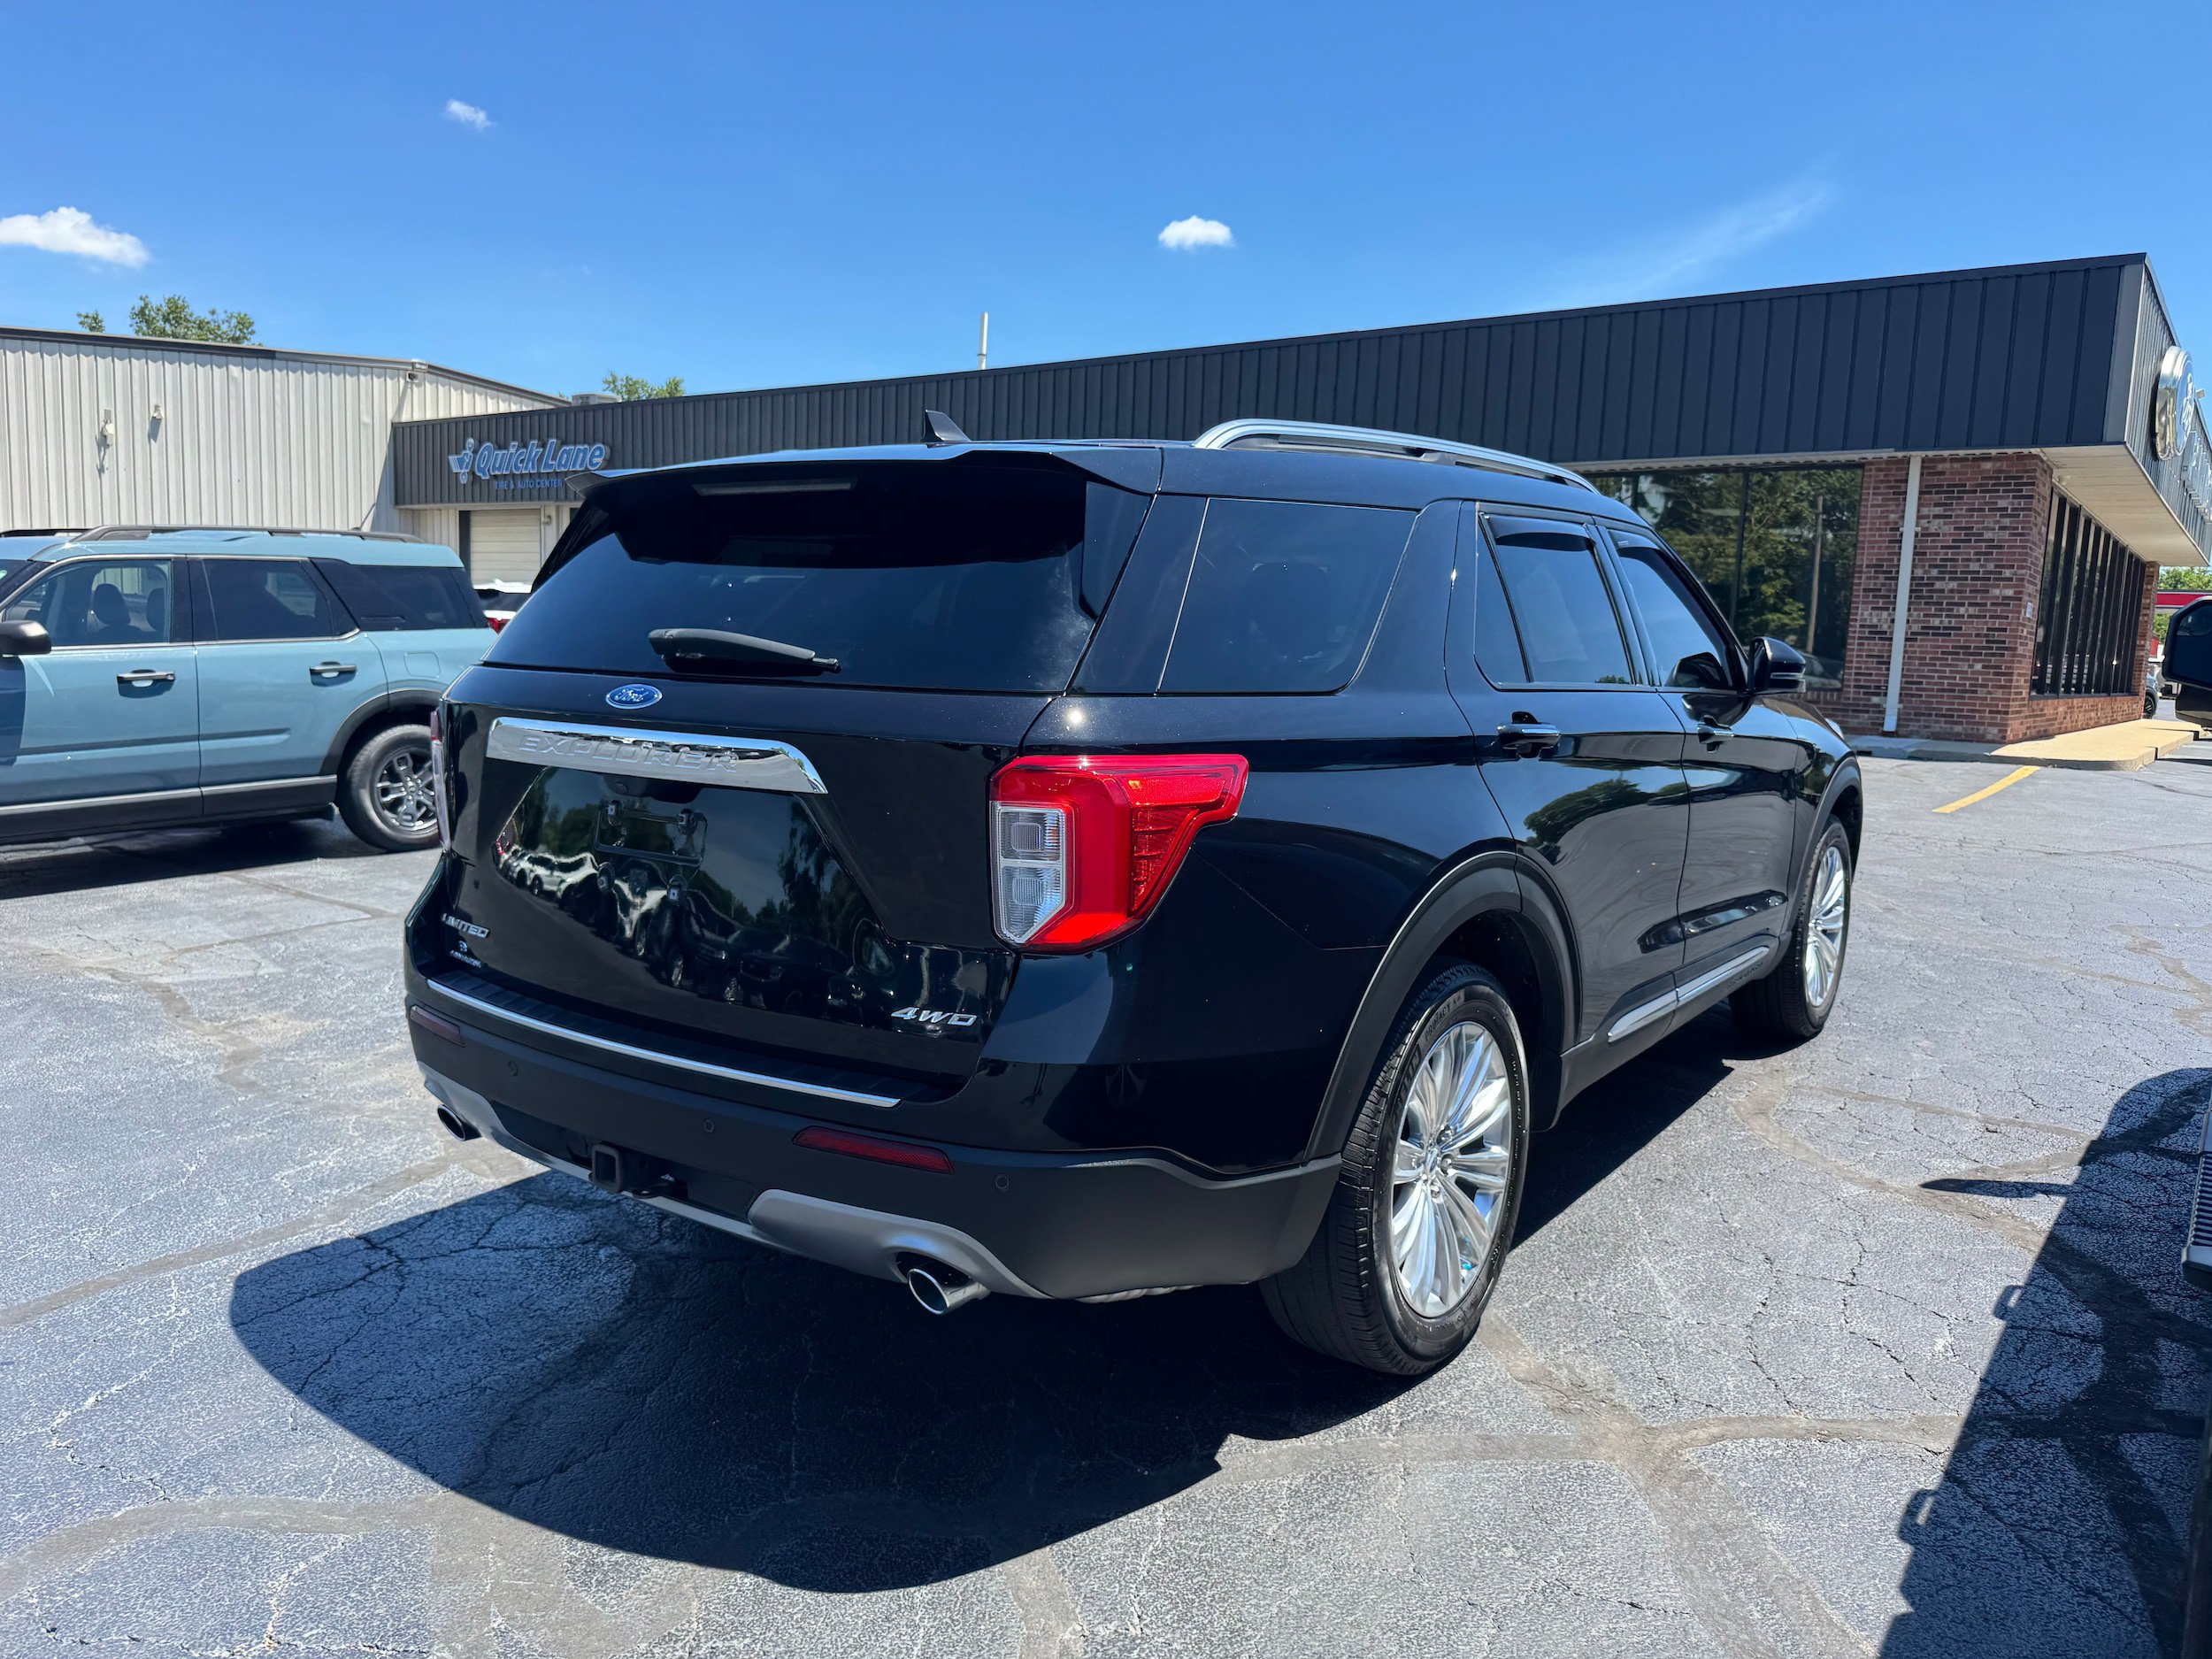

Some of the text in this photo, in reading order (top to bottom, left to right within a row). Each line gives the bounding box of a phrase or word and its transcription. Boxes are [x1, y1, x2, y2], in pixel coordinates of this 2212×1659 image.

[475, 439, 606, 480] Quick Lane
[517, 480, 534, 489] AUTO
[535, 479, 562, 488] CENTER
[614, 687, 649, 703] Ford
[519, 736, 739, 773] EXPLORER
[442, 912, 490, 939] LIMITED
[890, 1007, 978, 1026] 4WD
